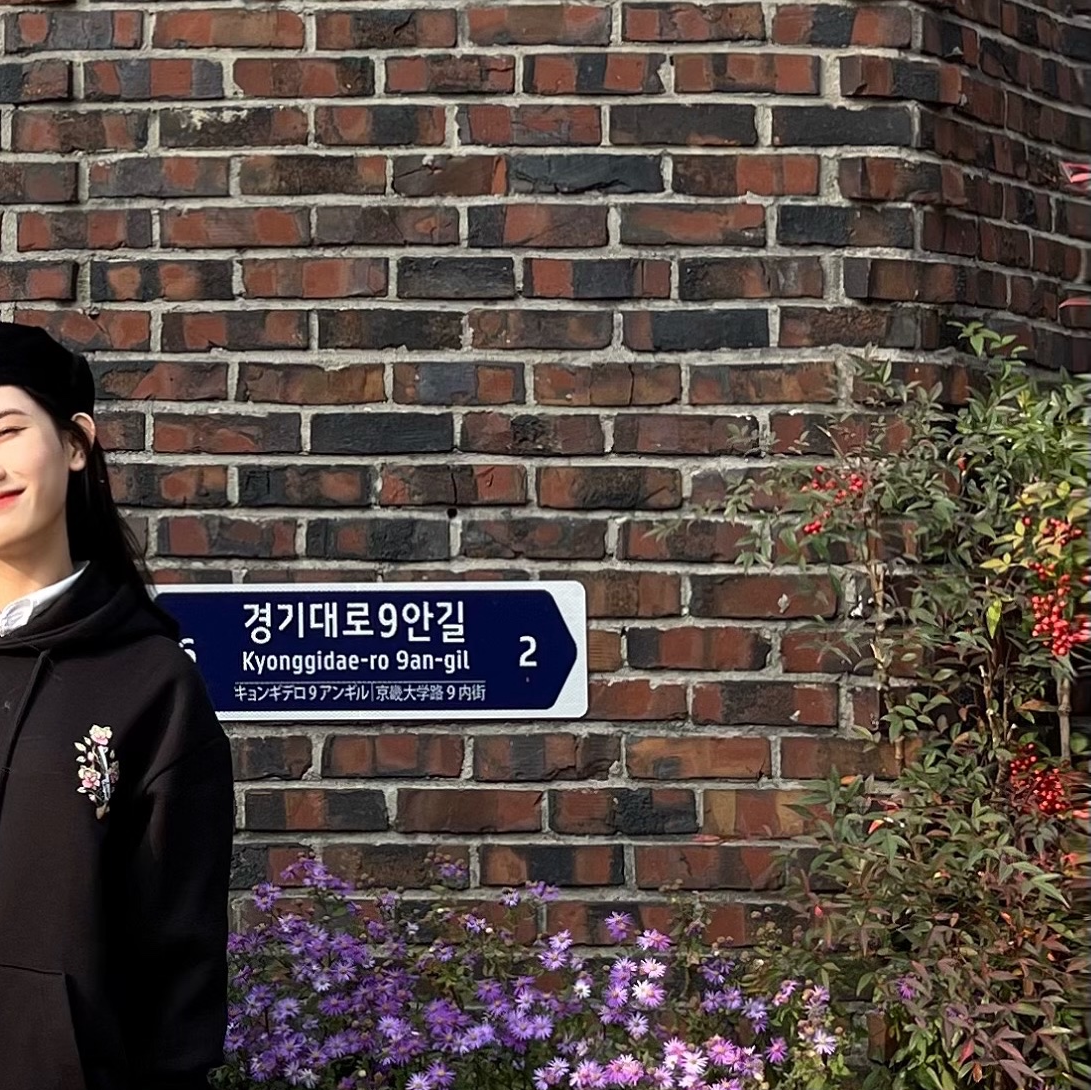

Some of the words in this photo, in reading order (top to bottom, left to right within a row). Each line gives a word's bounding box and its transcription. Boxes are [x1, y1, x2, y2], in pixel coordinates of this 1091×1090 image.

[243, 601, 465, 645] 경기대로9안길
[242, 650, 390, 675] Kyonggidae-ro
[396, 649, 470, 674] 9an-gil
[519, 635, 538, 667] 2
